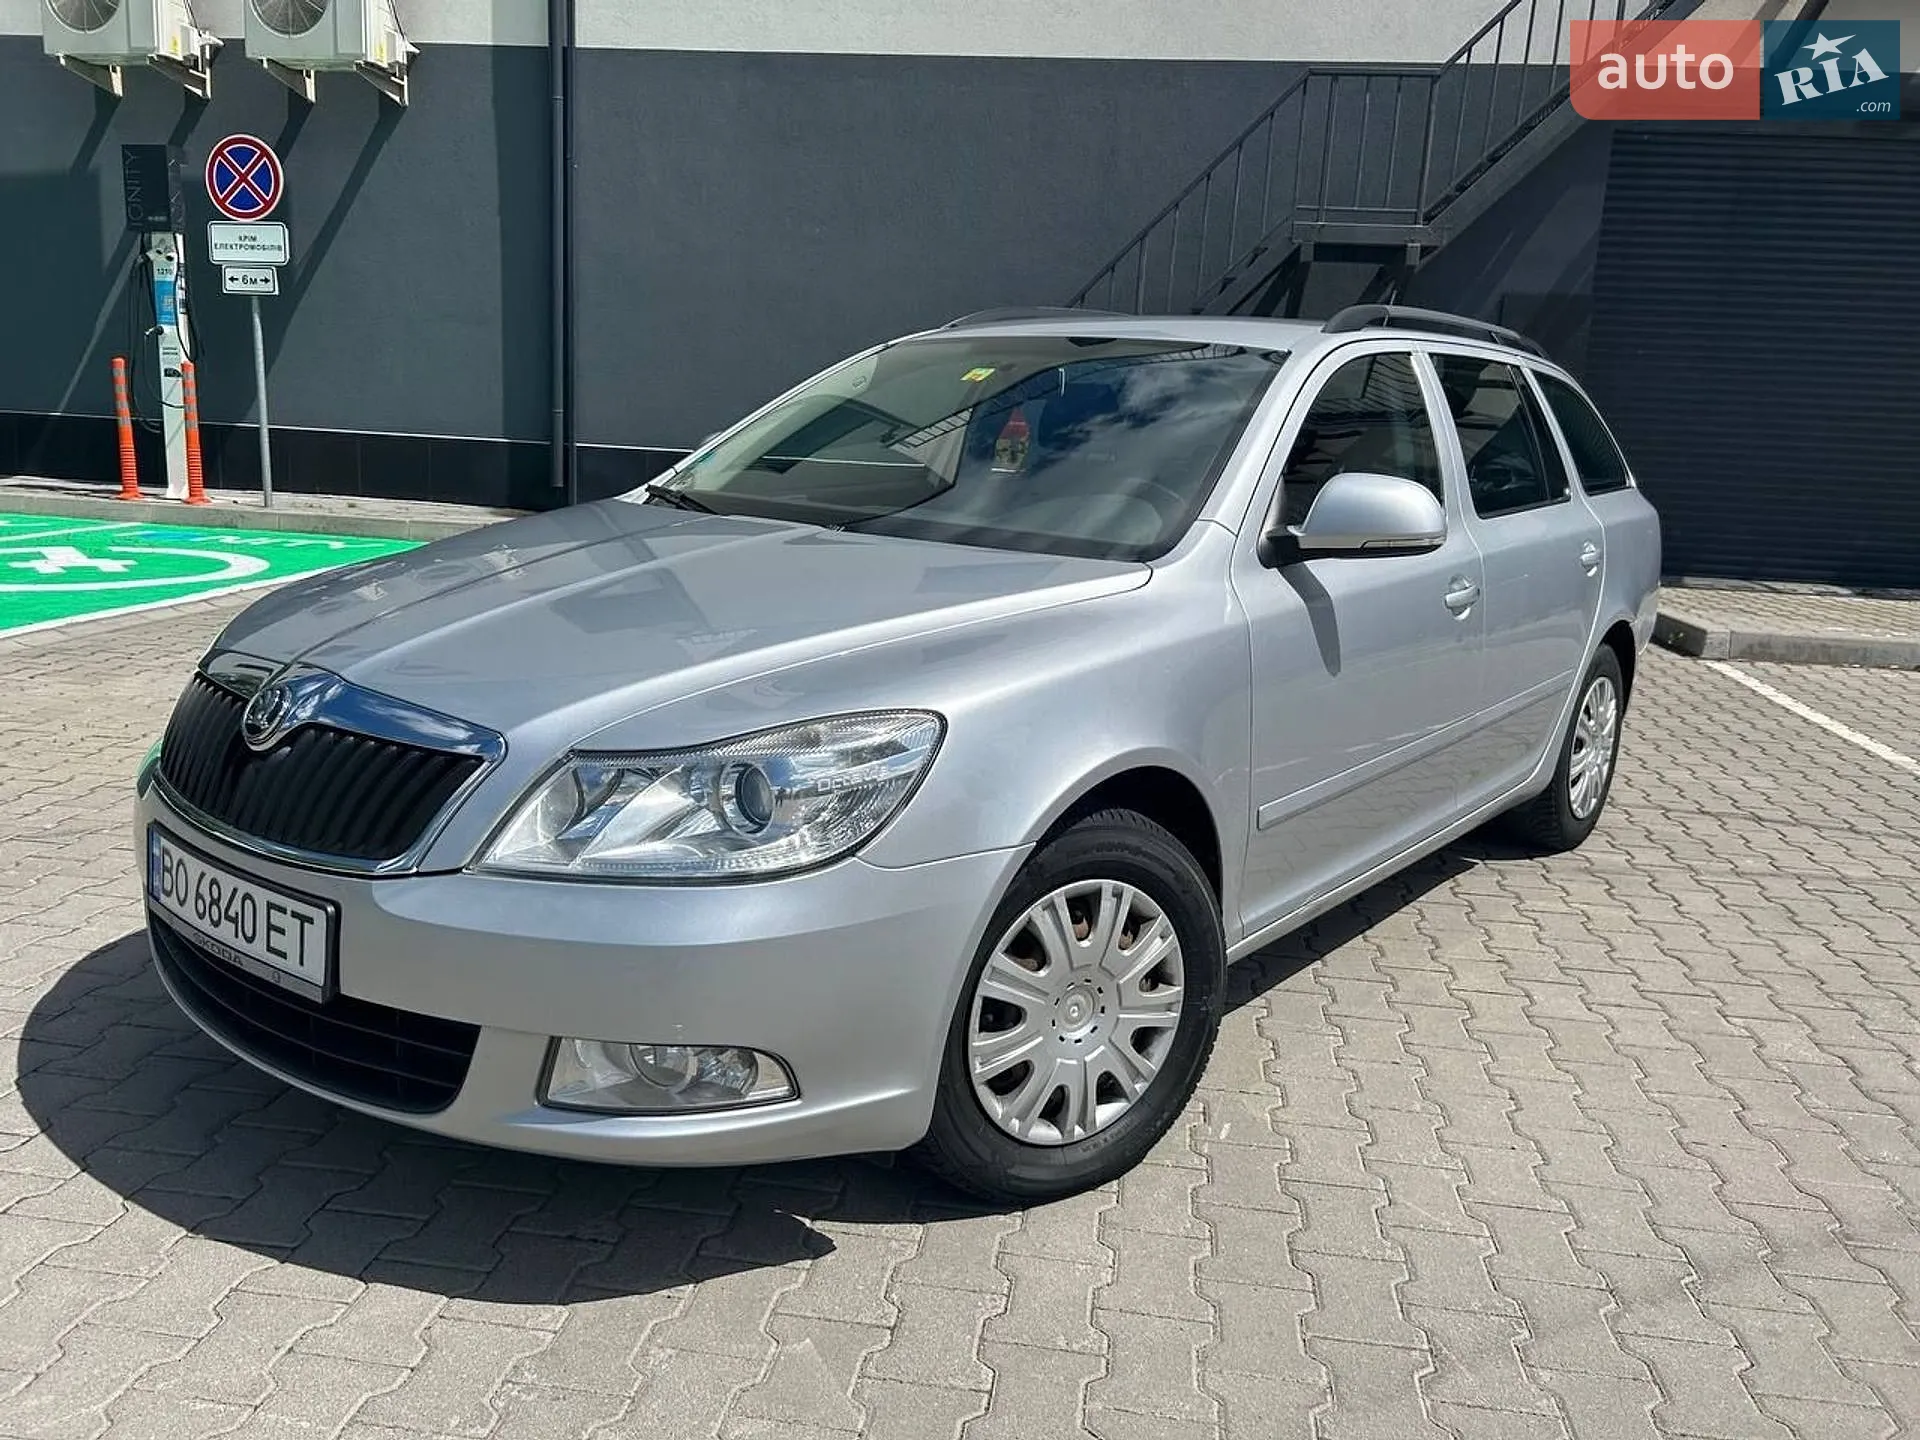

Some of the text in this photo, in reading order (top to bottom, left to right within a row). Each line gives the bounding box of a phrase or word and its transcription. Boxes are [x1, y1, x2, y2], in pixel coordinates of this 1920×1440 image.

[125, 150, 144, 226] IONITY
[161, 846, 315, 967] BO 6840 ET
